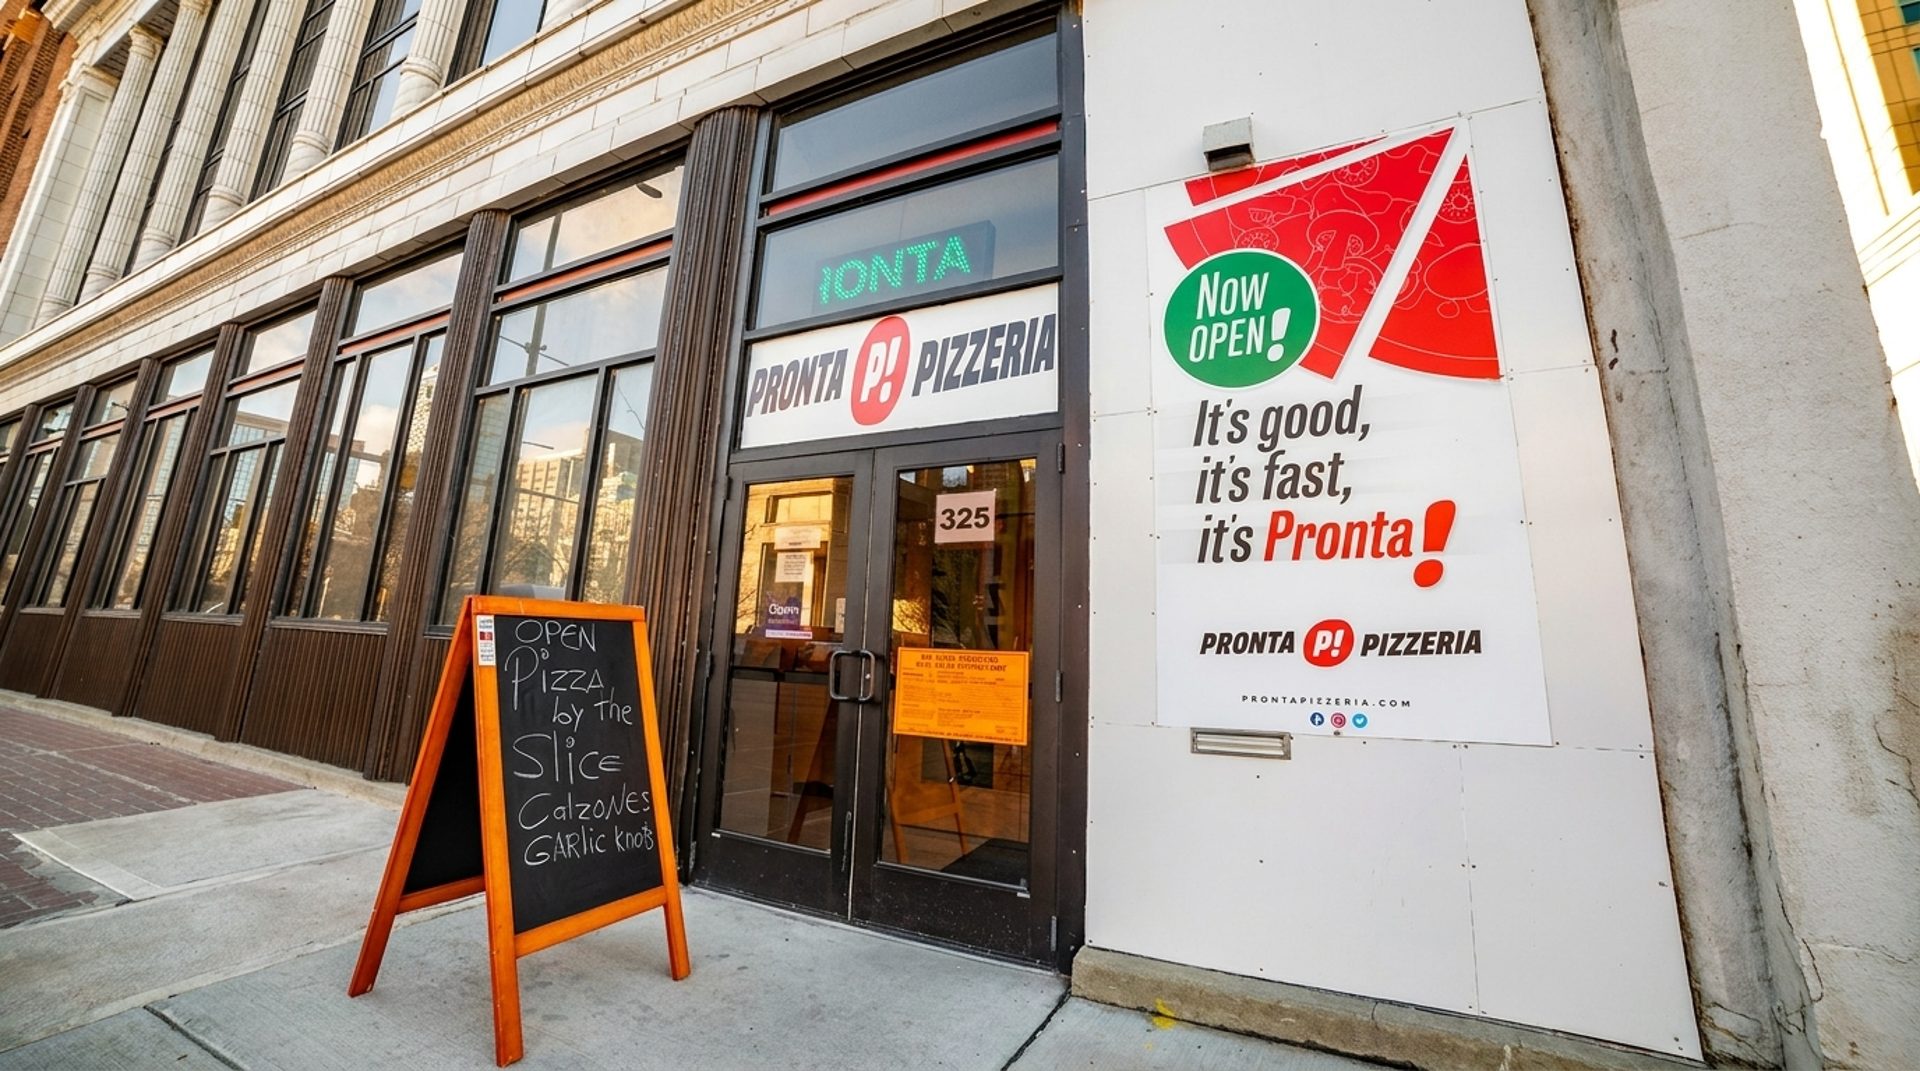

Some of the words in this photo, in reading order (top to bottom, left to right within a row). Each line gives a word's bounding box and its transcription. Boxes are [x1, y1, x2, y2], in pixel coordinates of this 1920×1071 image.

[1189, 307, 1291, 362] OPEN!
[746, 348, 848, 418] PRONTA
[860, 335, 902, 404] P!
[911, 313, 1057, 397] PIZZERIA
[1193, 398, 1250, 447] It's
[1257, 384, 1370, 453] good,
[1195, 455, 1251, 504] it's
[1262, 449, 1351, 505] fast,
[940, 507, 990, 530] 325
[1197, 514, 1254, 563] it's
[1263, 499, 1457, 588] Pronta!
[515, 619, 596, 652] OPEN
[1200, 631, 1295, 654] PRONTA
[1312, 629, 1345, 657] P!
[1360, 630, 1482, 656] PIZZERIA
[552, 696, 584, 732] by
[1242, 695, 1411, 707] PRONTAPIZZERIA.COM
